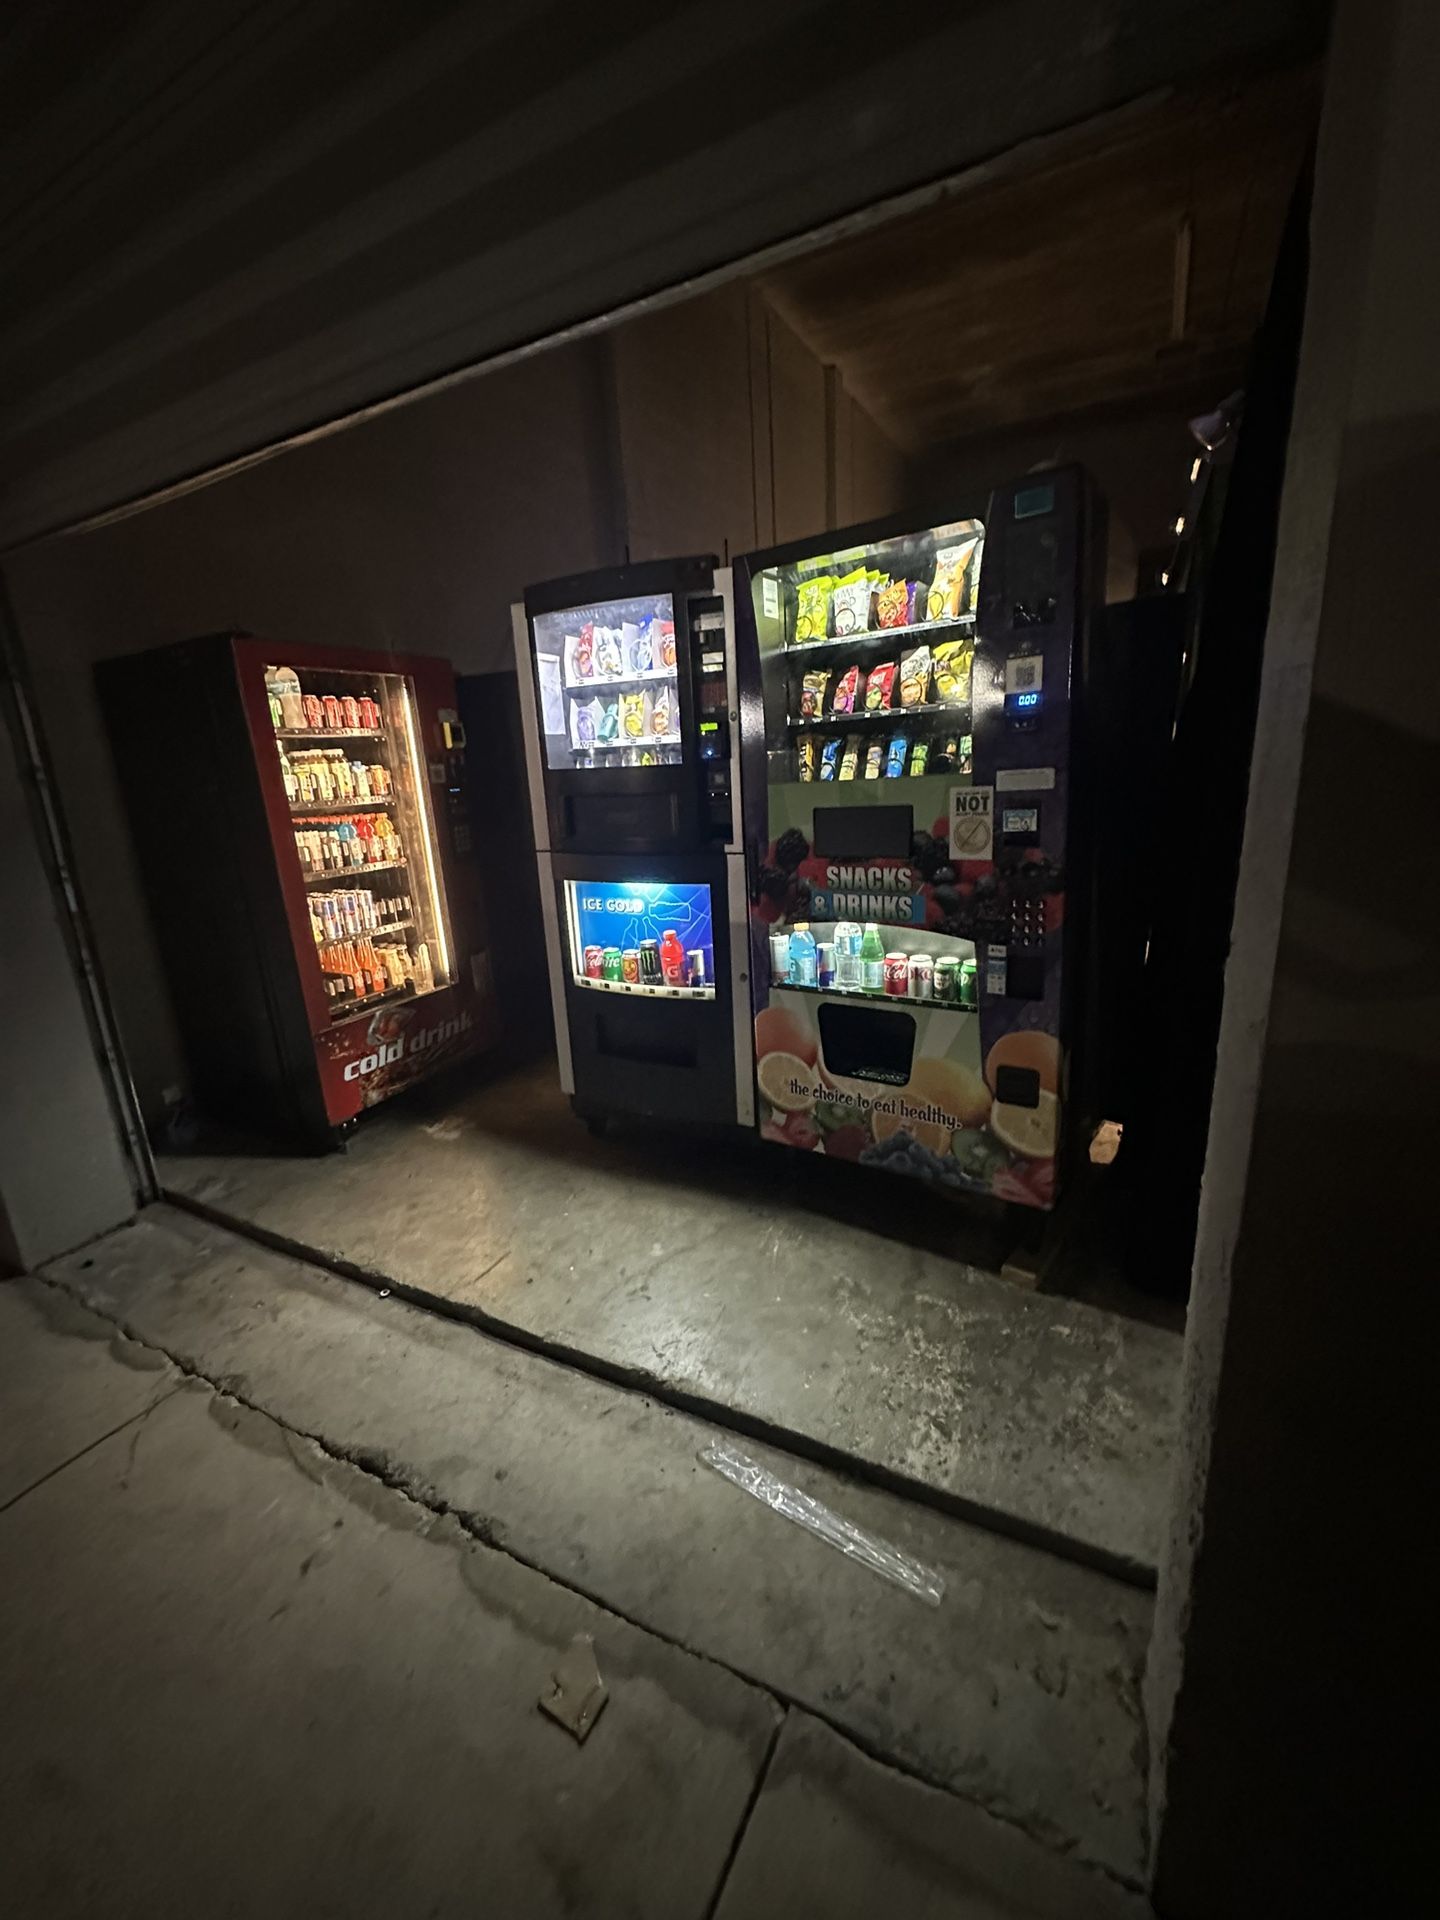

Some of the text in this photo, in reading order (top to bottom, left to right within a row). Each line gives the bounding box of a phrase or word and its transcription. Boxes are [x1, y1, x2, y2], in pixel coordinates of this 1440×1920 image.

[956, 796, 990, 811] NOT
[826, 866, 912, 892] SNACKS
[583, 898, 645, 913] ICE COLD
[814, 893, 913, 920] & DRINKS
[666, 965, 678, 977] G
[344, 1009, 473, 1081] cold drink
[789, 1079, 962, 1130] the choice to eat healthy.
